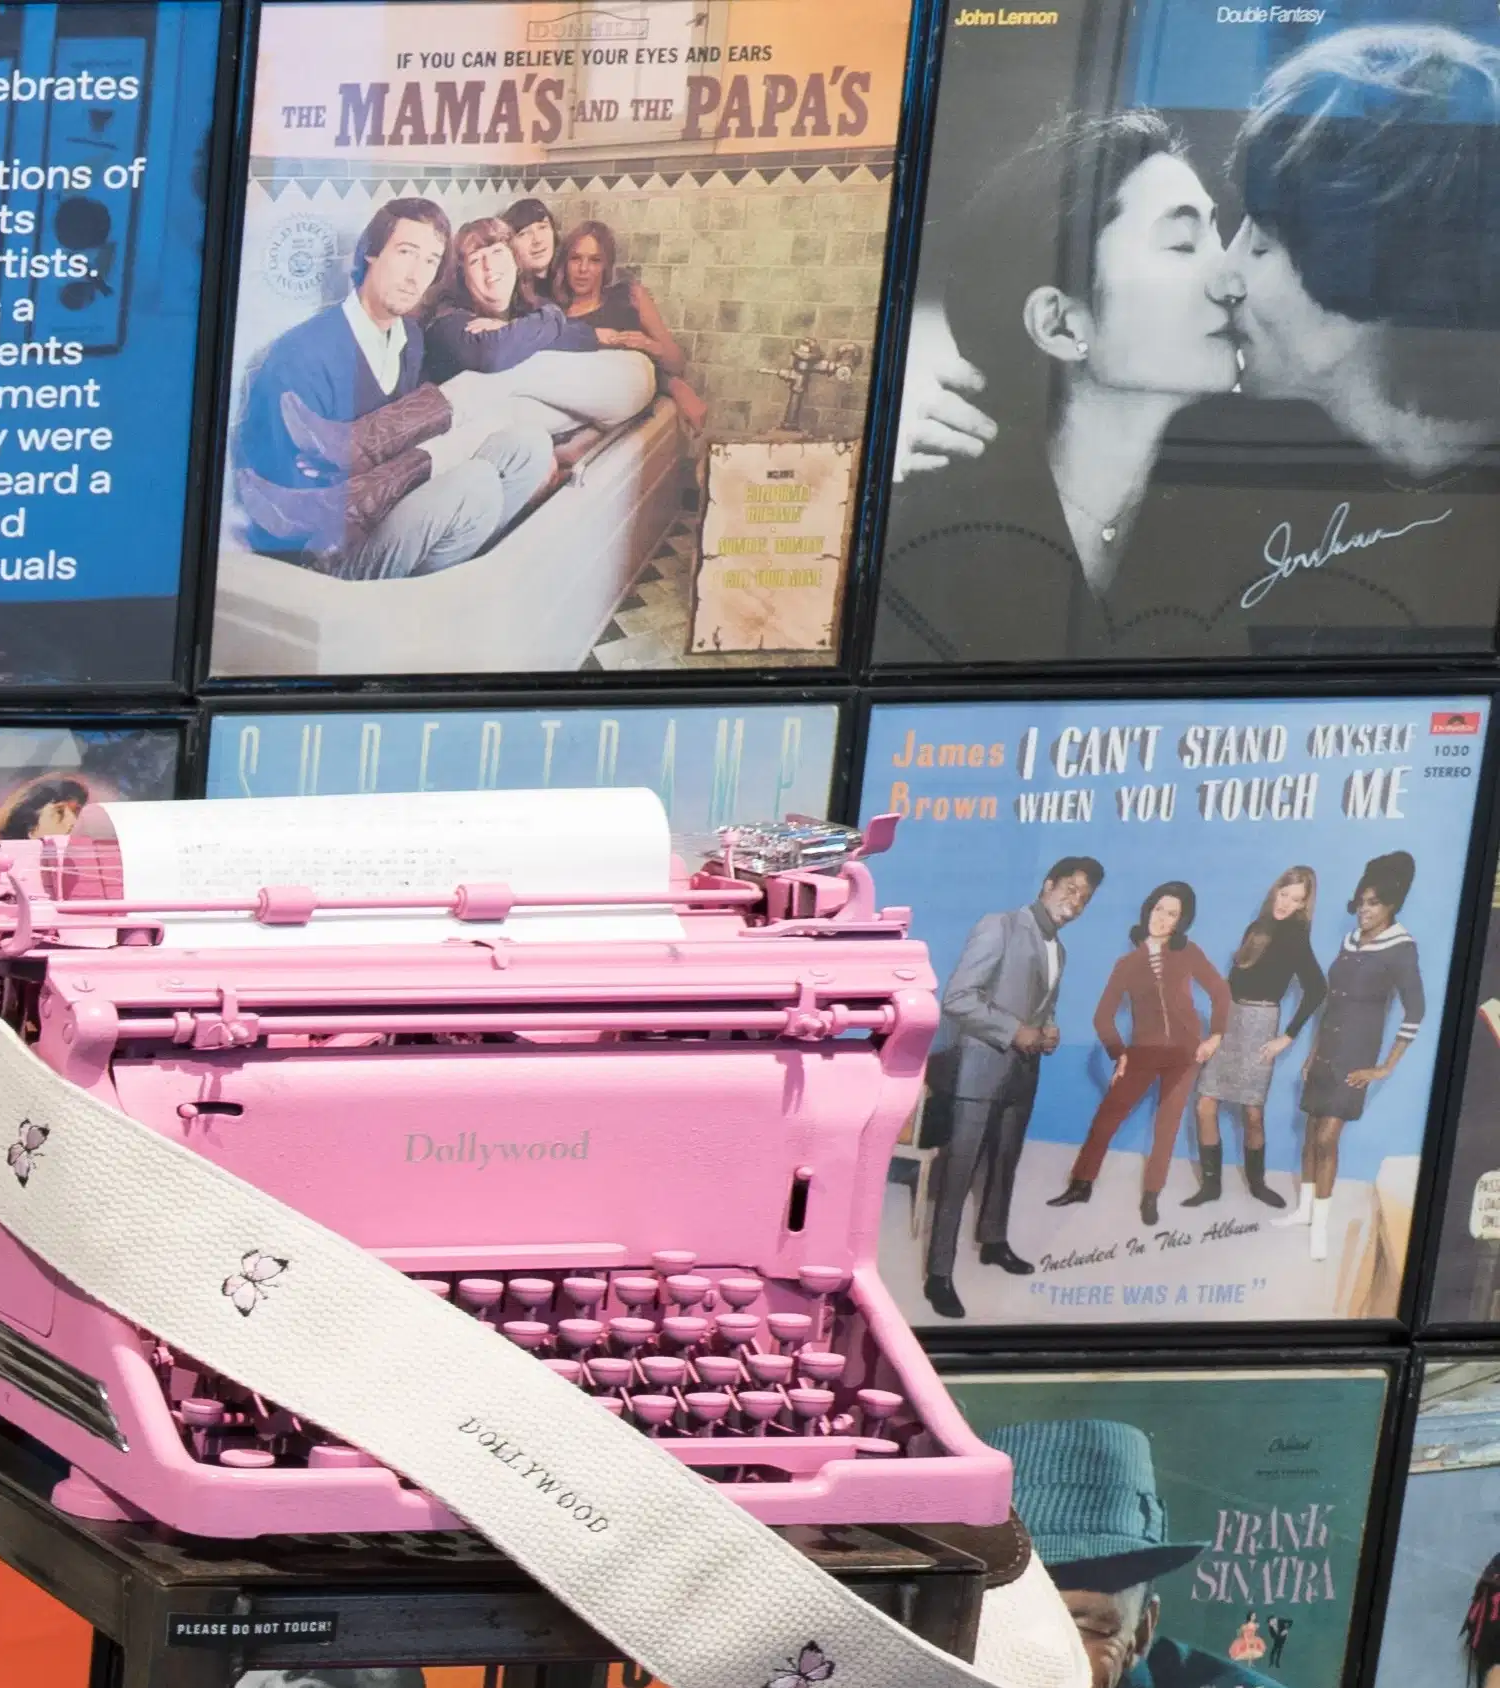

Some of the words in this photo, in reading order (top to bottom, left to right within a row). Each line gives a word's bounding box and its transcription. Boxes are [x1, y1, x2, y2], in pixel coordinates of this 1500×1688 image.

[955, 7, 993, 26] John
[998, 7, 1059, 25] Lennon
[1216, 4, 1267, 24] Double
[1269, 4, 1326, 25] Fantasy
[396, 53, 413, 69] IF
[419, 52, 457, 69] YOU
[461, 51, 497, 68] CAN
[503, 49, 575, 68] BELIEVE
[581, 47, 629, 66] YOUR
[634, 46, 679, 65] EYES
[685, 45, 721, 63] AND
[727, 44, 773, 62] EARS
[281, 106, 327, 129] THE
[334, 72, 566, 147] MAMA'S
[573, 99, 620, 124] AND
[630, 97, 674, 122] THE
[681, 65, 872, 143] PAPA'S
[103, 157, 147, 190] of
[12, 298, 34, 322] a
[17, 427, 113, 452] were
[89, 470, 111, 494] a
[891, 729, 1005, 769] James
[1056, 724, 1163, 780] CAN'T
[1182, 723, 1287, 767] STAND
[1310, 722, 1418, 760] MYSELF
[1432, 745, 1470, 757] 1030
[1423, 765, 1472, 779] STEREO
[890, 780, 998, 820] Brown
[1017, 788, 1094, 824] WHEN
[1119, 783, 1177, 822] YOU
[1201, 772, 1319, 823] TOUCH
[1345, 768, 1412, 820] ME
[404, 1129, 591, 1171] Dollywood
[1040, 1243, 1117, 1273] Included
[1126, 1237, 1146, 1257] In
[1154, 1228, 1193, 1251] This
[1200, 1217, 1260, 1244] Album
[458, 1416, 609, 1533] DOLLYWOOD
[1211, 1503, 1336, 1556] FRANK
[1191, 1555, 1336, 1605] SINATRA
[176, 1623, 230, 1636] PLEASE
[232, 1622, 251, 1635] DO
[254, 1621, 280, 1634] NOT
[282, 1620, 332, 1633] TOUCH!
